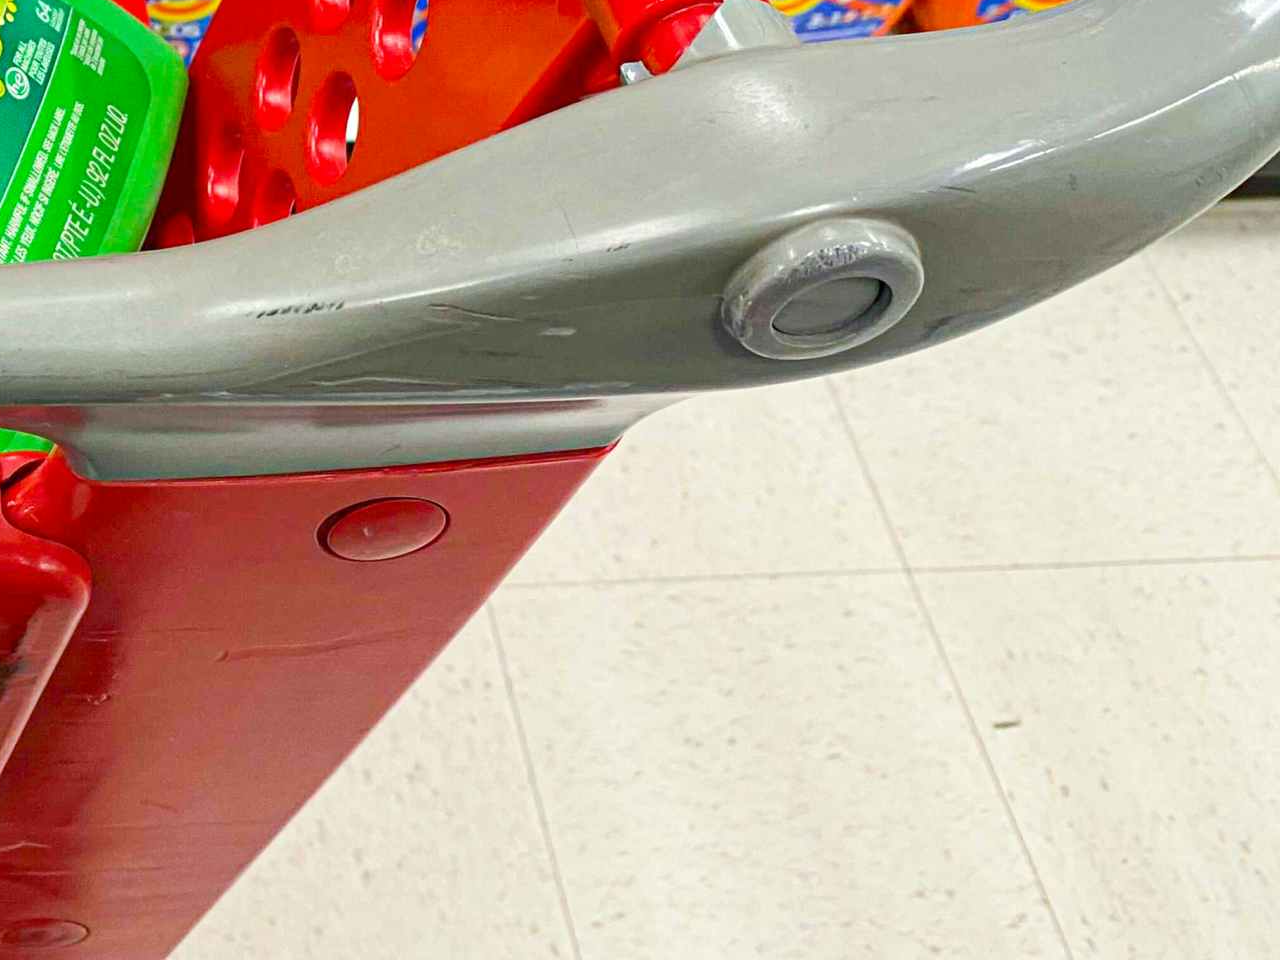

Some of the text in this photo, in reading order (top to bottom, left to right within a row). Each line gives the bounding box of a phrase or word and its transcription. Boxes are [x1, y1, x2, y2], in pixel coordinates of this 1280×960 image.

[35, 0, 52, 23] 64
[98, 122, 122, 153] OZ
[92, 146, 116, 171] FL
[86, 160, 111, 188] 92
